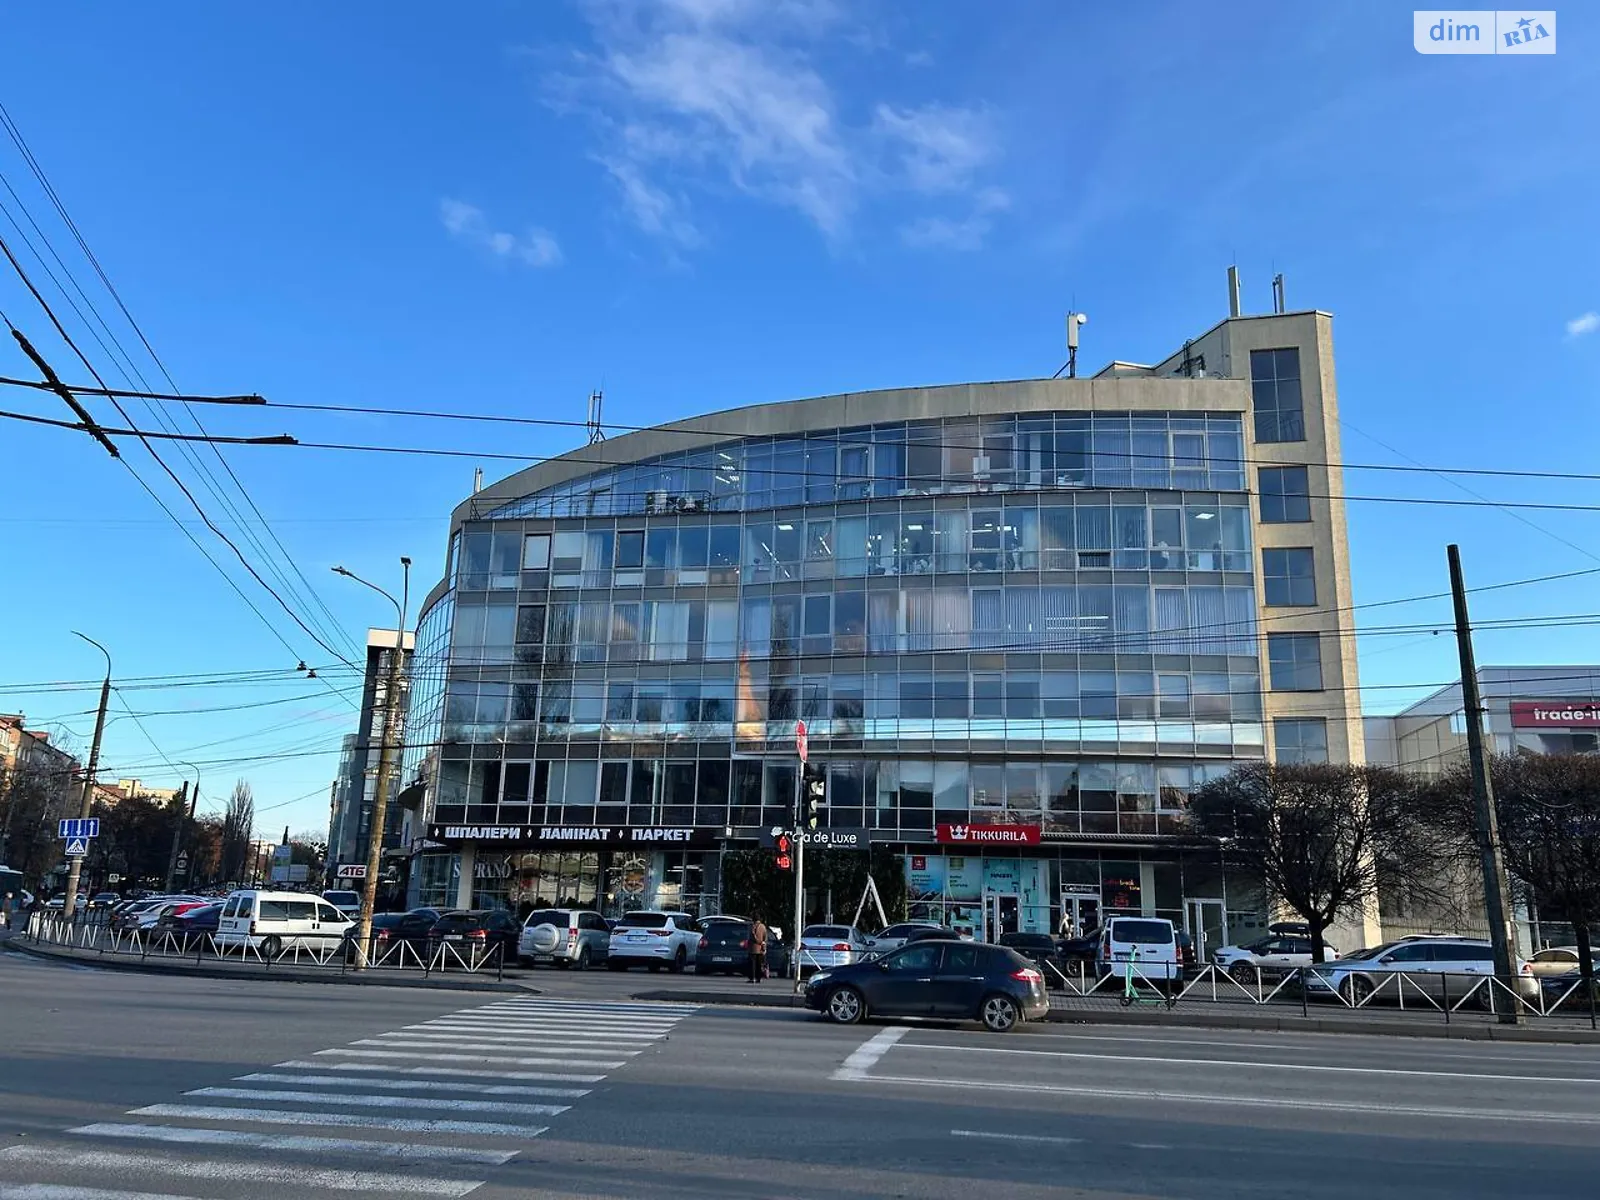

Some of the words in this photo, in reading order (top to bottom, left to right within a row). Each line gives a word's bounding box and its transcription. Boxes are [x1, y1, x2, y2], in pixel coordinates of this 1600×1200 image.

[1533, 705, 1600, 720] trade-i
[444, 827, 521, 839] ШПАЛЕРИ
[539, 828, 611, 840] ЛАМІНАТ
[631, 829, 694, 841] ПАРКЕТ
[813, 831, 829, 844] de
[831, 831, 857, 844] Luxe
[970, 830, 1028, 841] TIKKURILA
